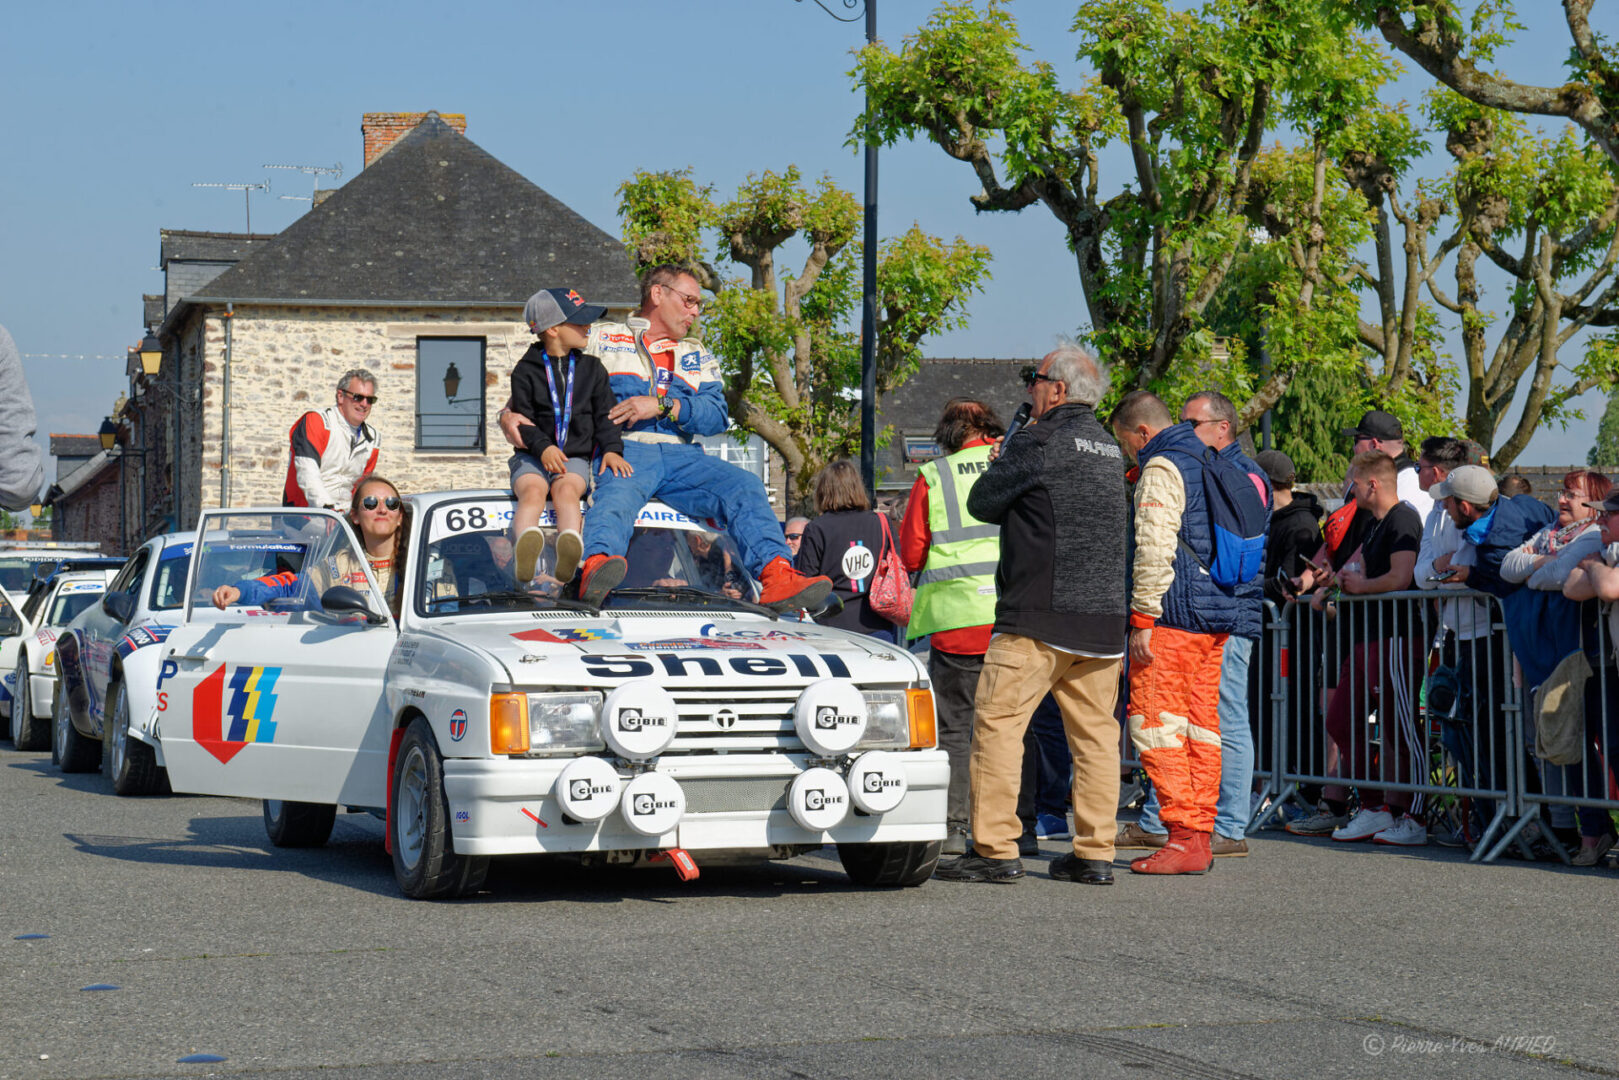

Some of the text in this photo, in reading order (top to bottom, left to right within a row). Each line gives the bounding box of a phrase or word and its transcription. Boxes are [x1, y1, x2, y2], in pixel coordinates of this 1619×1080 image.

[958, 462, 991, 474] ME
[445, 506, 487, 531] 68
[845, 553, 869, 573] VHC
[580, 653, 852, 678] Shell
